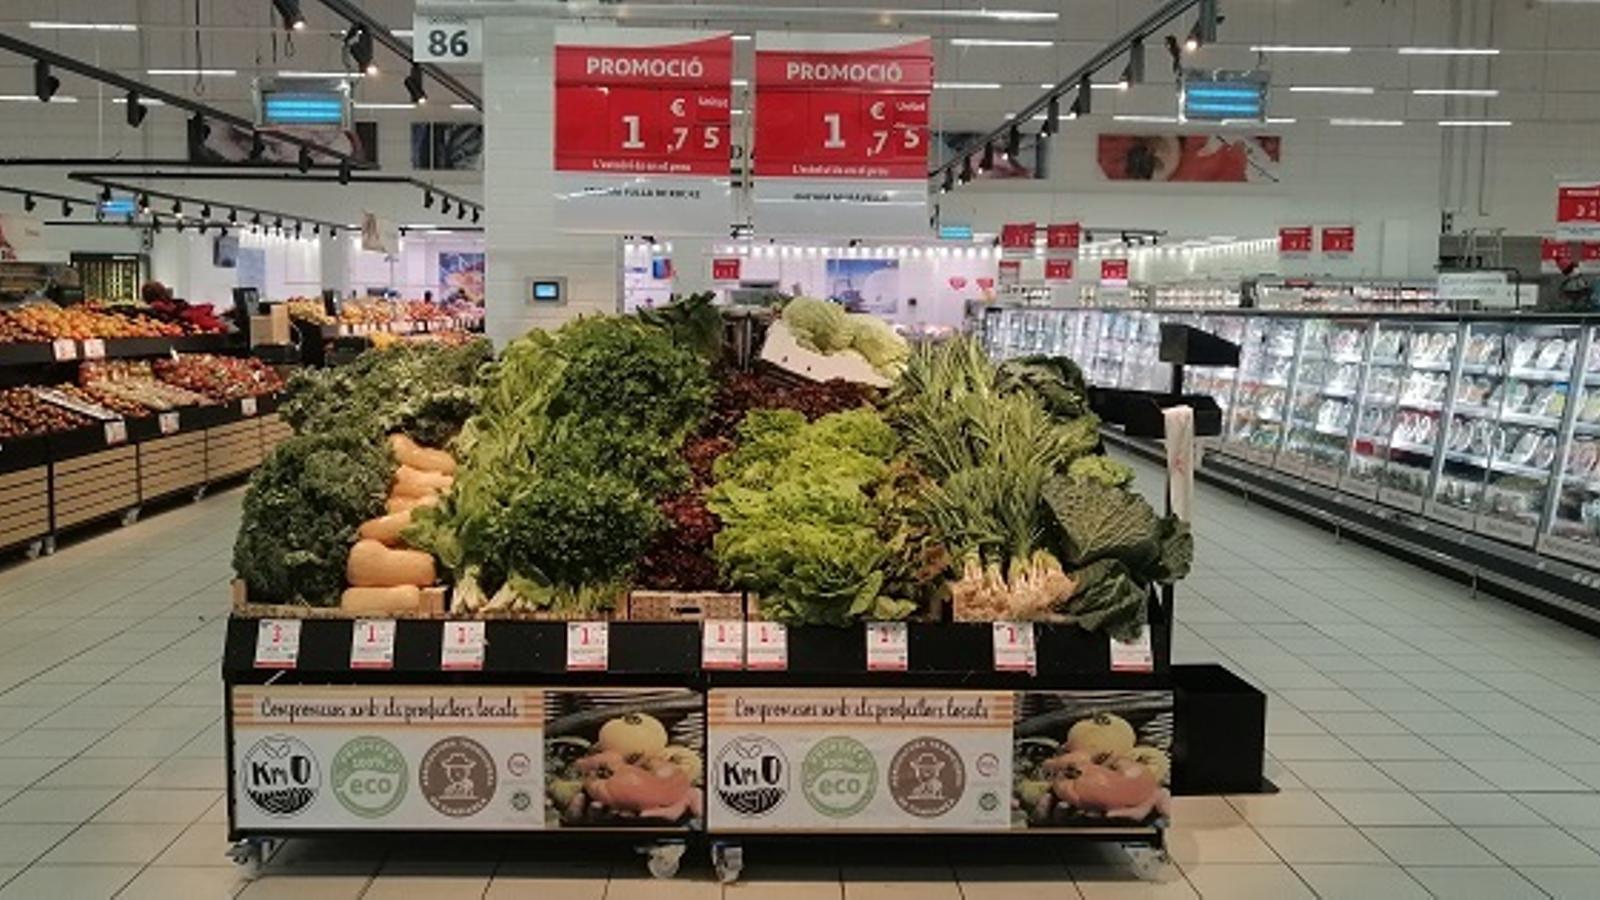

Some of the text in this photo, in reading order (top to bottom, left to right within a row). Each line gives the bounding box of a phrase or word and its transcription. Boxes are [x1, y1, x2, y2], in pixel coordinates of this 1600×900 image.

[428, 30, 469, 57] 86
[586, 56, 703, 78] PROMOCIÓ
[786, 62, 903, 82] PROMOCIÓ
[670, 98, 686, 117] €
[870, 102, 886, 120] €
[476, 696, 519, 719] locals
[946, 696, 988, 719] locals
[350, 777, 392, 795] eco
[818, 778, 861, 795] eco
